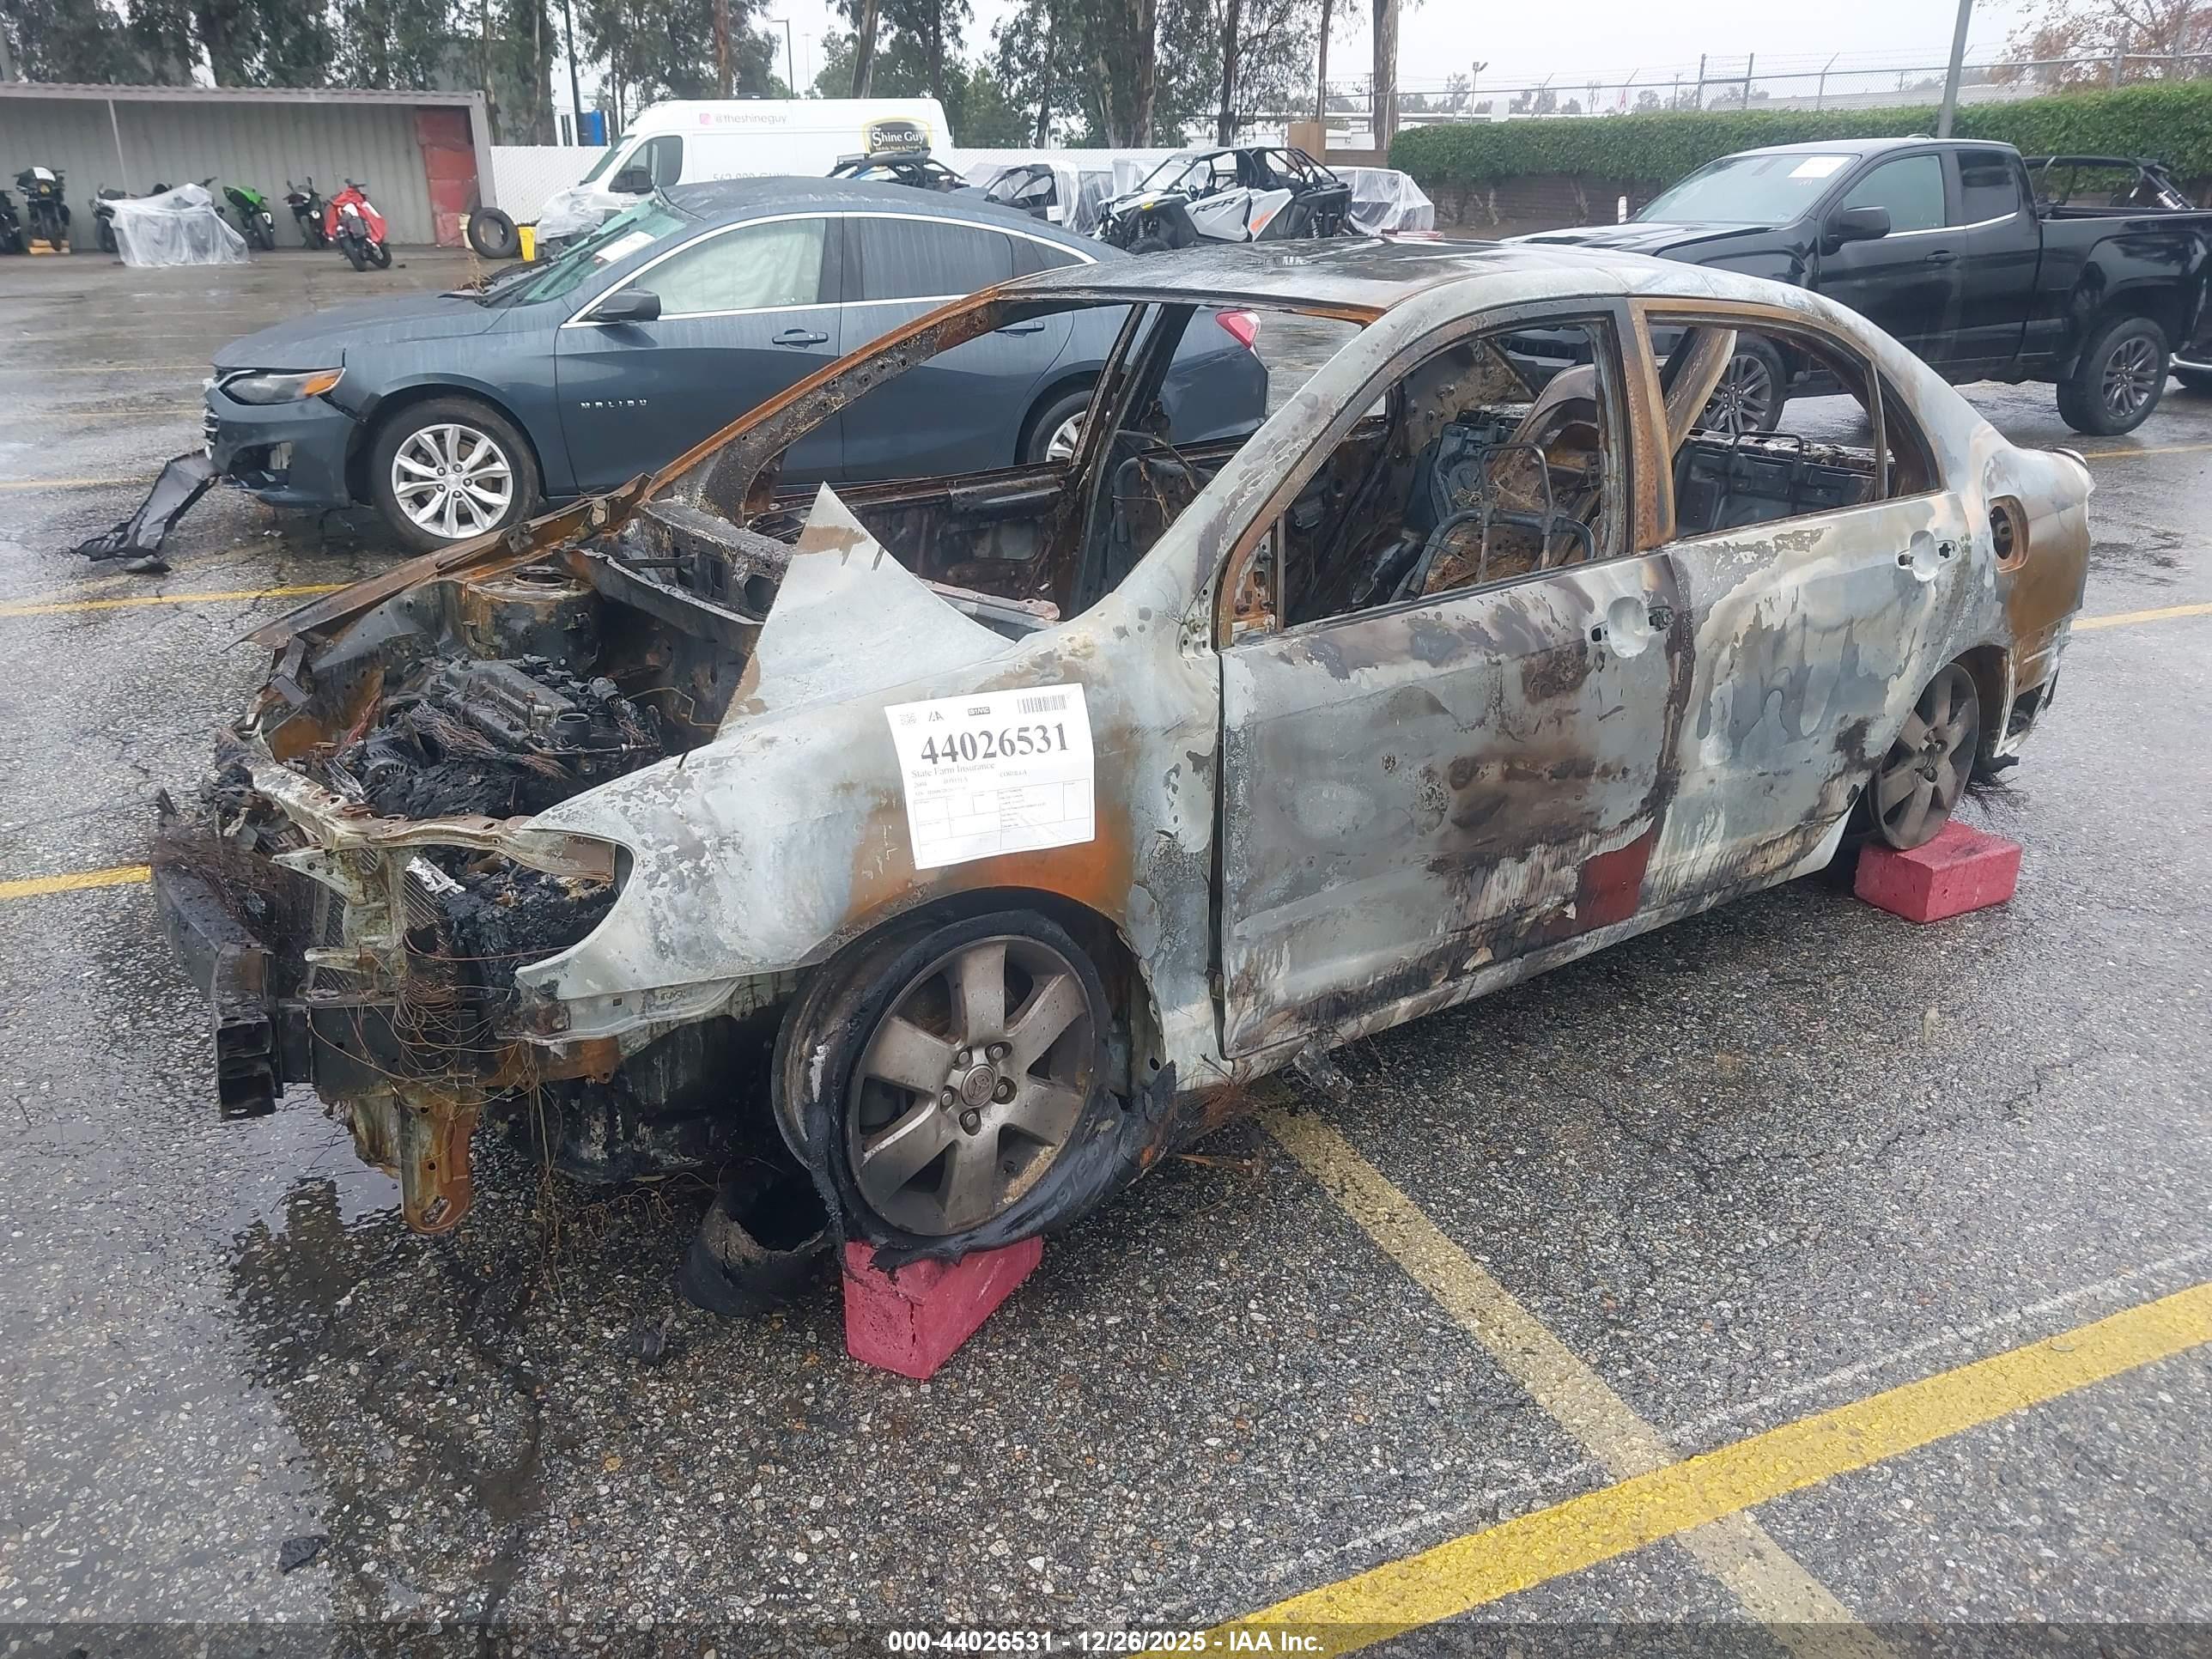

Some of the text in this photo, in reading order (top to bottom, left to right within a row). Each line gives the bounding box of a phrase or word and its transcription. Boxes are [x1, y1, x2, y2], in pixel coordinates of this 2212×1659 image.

[714, 113, 787, 125] @theshineguy
[872, 131, 925, 147] Shine Guy
[1193, 197, 1237, 216] RZR
[921, 722, 1070, 765] 44026531
[911, 763, 995, 779] State Farm Insurance
